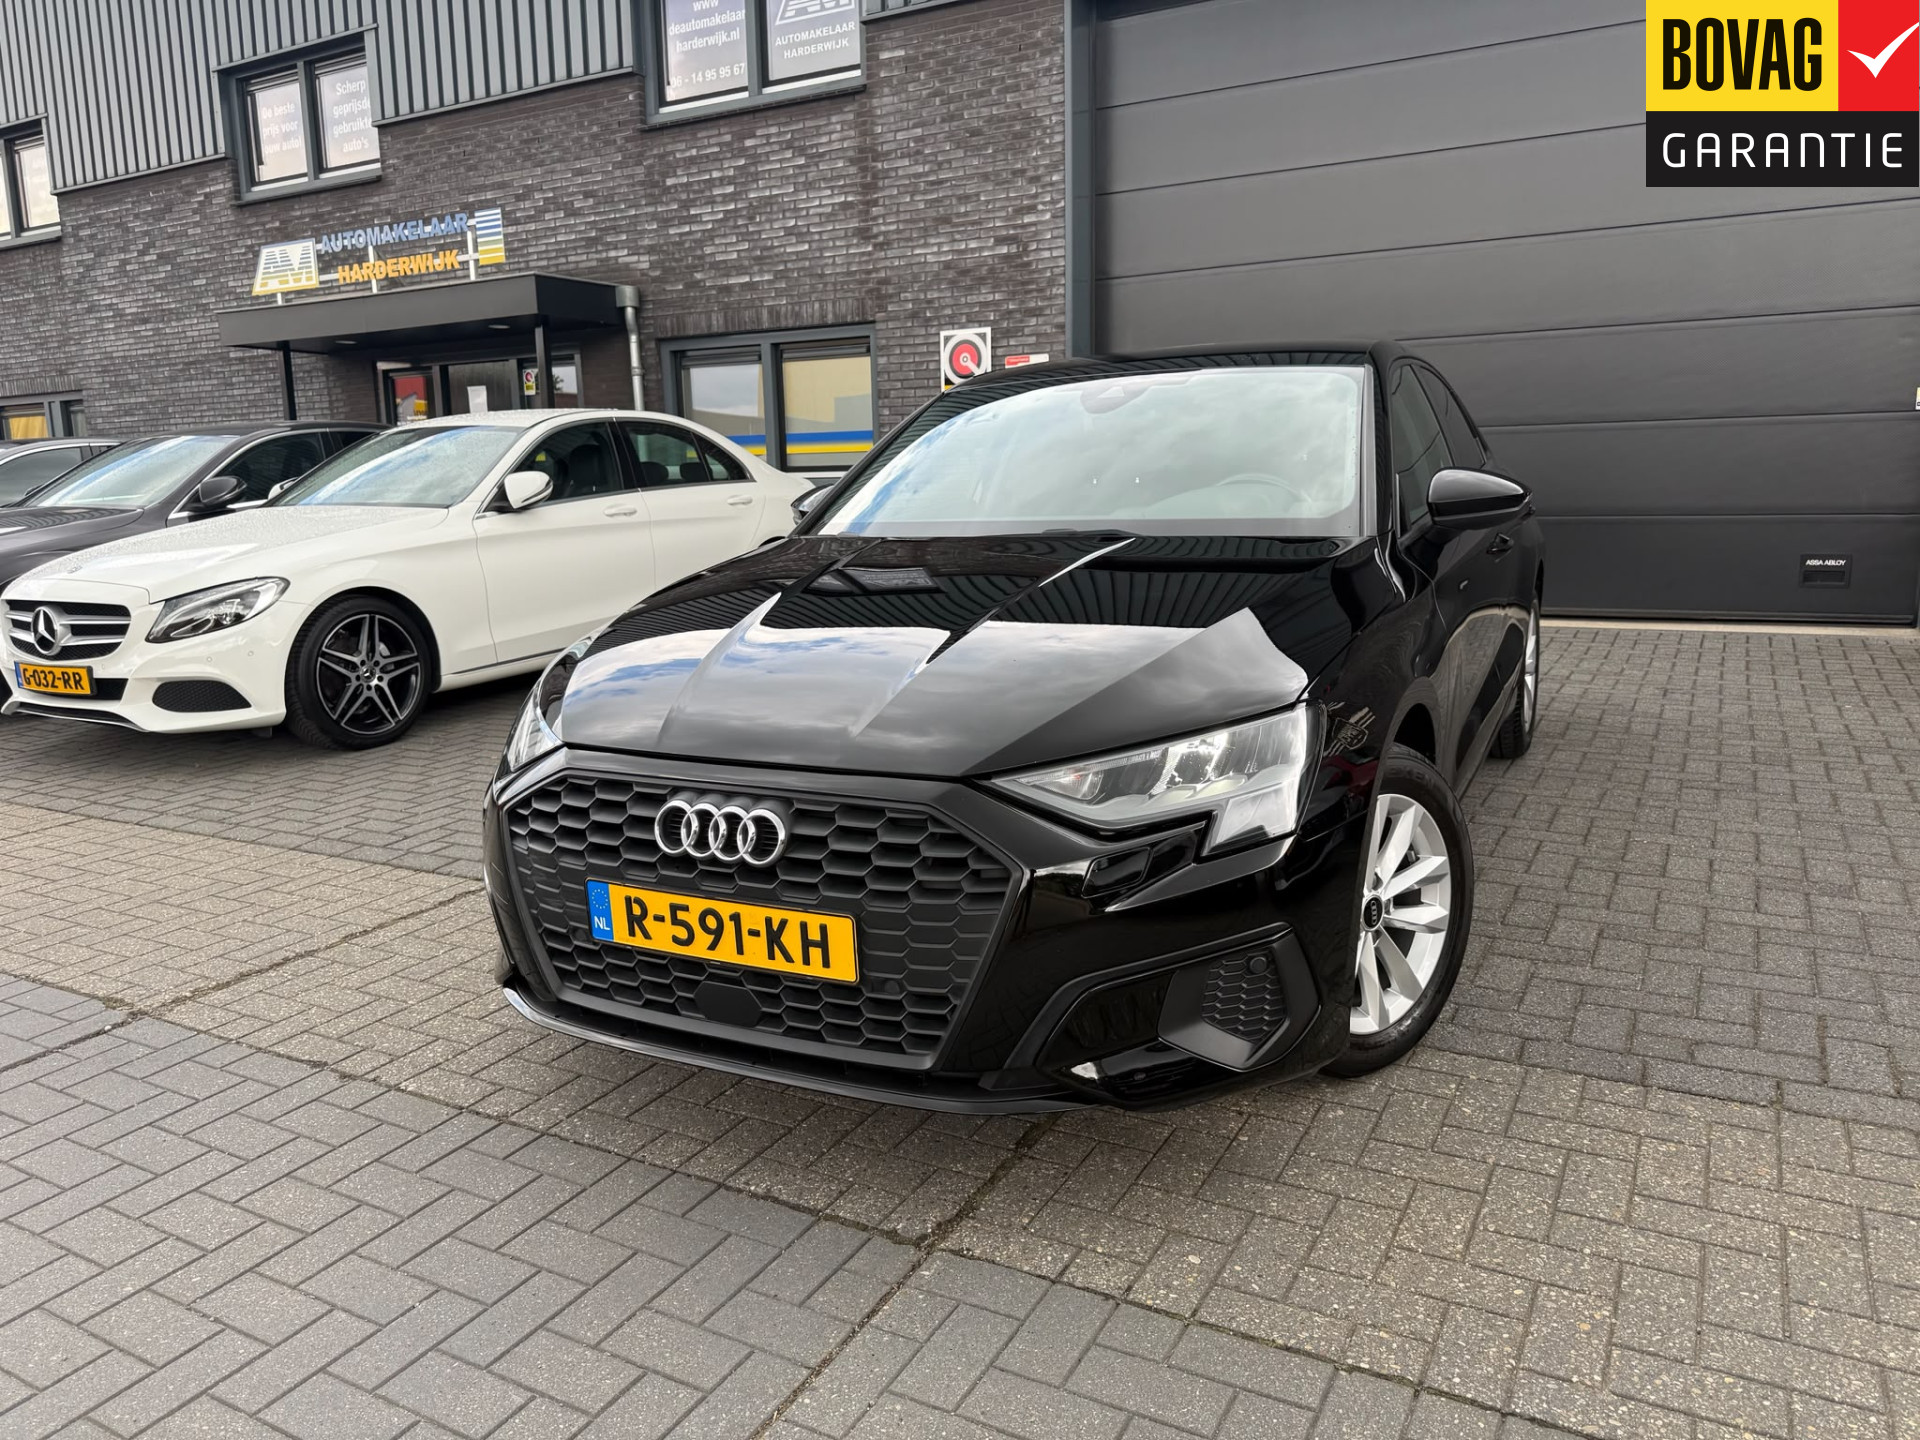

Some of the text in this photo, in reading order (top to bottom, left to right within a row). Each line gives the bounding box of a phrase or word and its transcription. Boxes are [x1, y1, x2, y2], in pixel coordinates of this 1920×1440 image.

[693, 0, 718, 12] www
[669, 9, 746, 36] deautomakelaar
[775, 21, 856, 46] AUTOMAKELAAR
[676, 27, 740, 53] harderwijk.nl
[783, 38, 850, 59] HARDERWIJK
[670, 75, 683, 89] 06
[691, 71, 703, 84] 14
[705, 68, 717, 82] 95
[719, 65, 732, 79] 95
[733, 62, 746, 76] 67
[336, 80, 366, 96] Scherp
[274, 102, 296, 116] beste
[280, 120, 298, 133] voor
[342, 136, 370, 153] auto's
[320, 213, 469, 255] AUTOMAKELAAR
[337, 249, 460, 285] HARDERWIJK
[22, 667, 85, 691] G-032-RR
[594, 914, 611, 931] NL
[624, 894, 831, 969] R-591-KH
